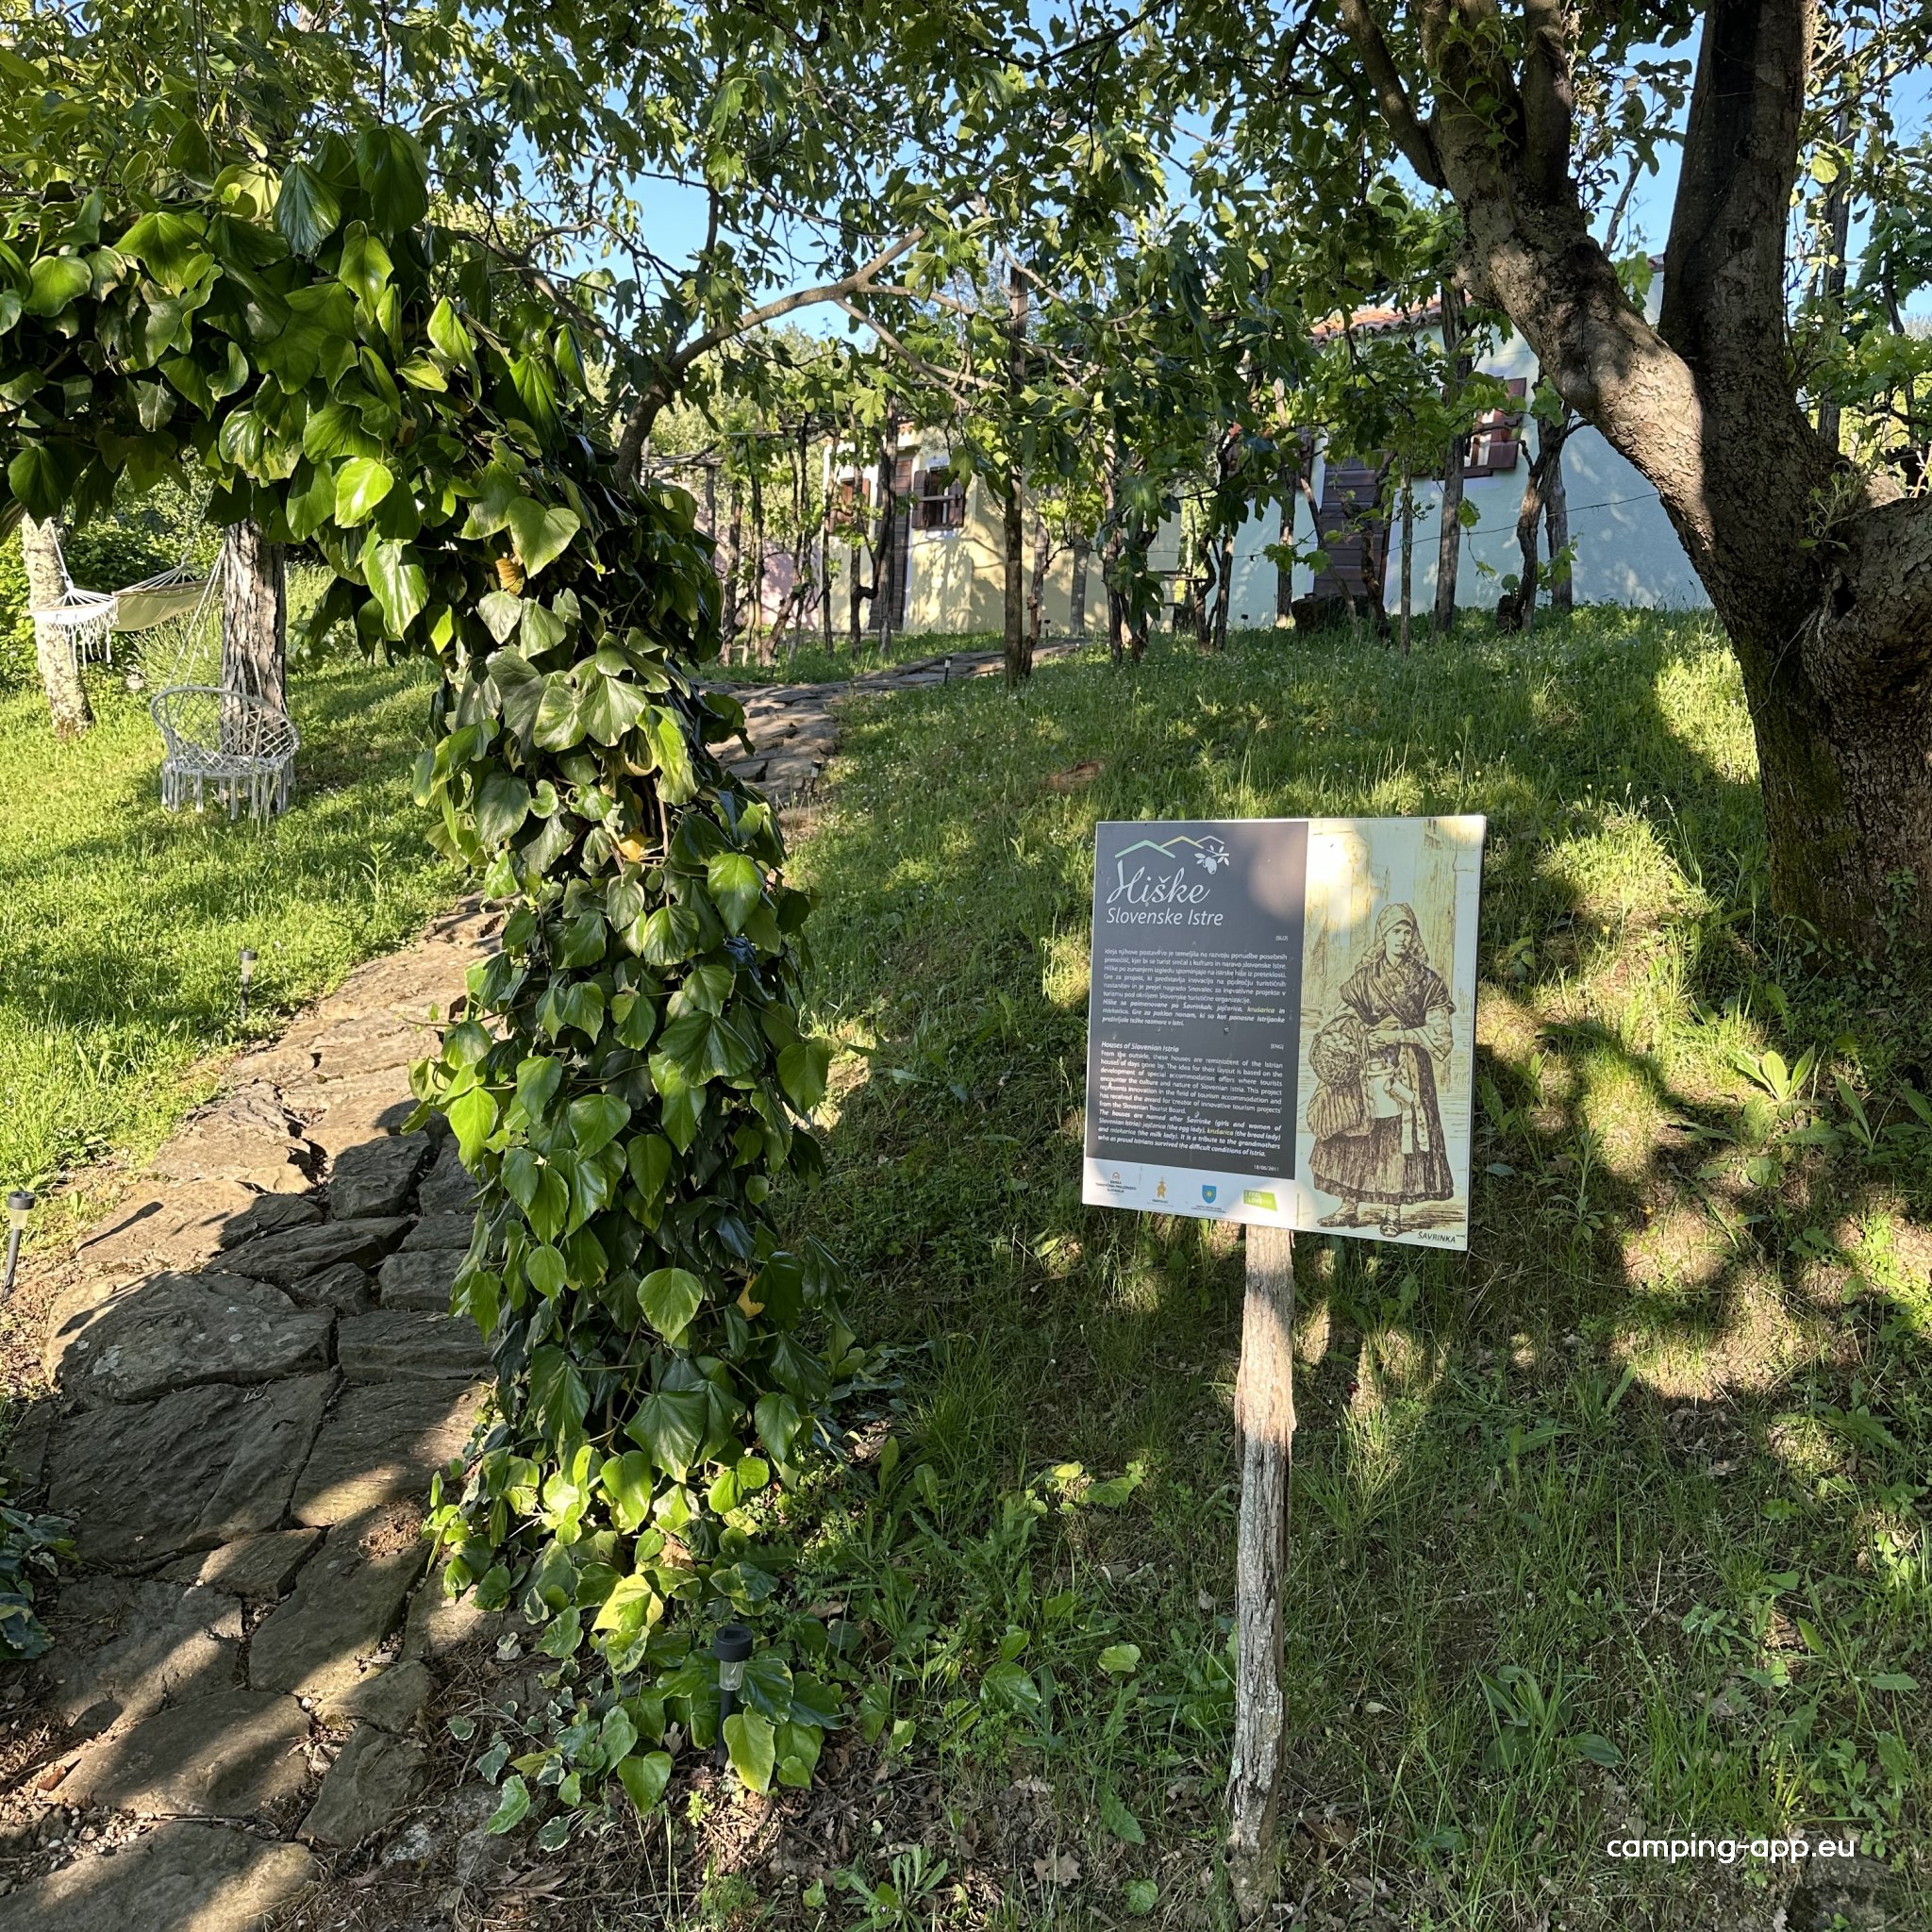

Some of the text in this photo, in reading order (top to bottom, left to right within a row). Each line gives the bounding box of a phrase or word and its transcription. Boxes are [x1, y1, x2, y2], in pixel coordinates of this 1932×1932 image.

[1107, 859, 1210, 904] Hiške
[1107, 908, 1224, 925] Slovenske Istre
[1131, 1043, 1162, 1051] Slovenian
[1101, 1067, 1135, 1076] development
[1147, 1071, 1166, 1079] special
[1169, 1072, 1215, 1081] accommodation
[1217, 1067, 1235, 1075] layout
[1261, 1088, 1282, 1097] project
[1221, 1094, 1268, 1103] accommodation
[1201, 1101, 1231, 1109] innovative
[1215, 1120, 1229, 1128] (girls
[1265, 1133, 1281, 1141] lady)
[1238, 1140, 1280, 1150] grandmothers
[1211, 1146, 1242, 1154] conditions
[1418, 1231, 1456, 1243] ŠAVRINKA
